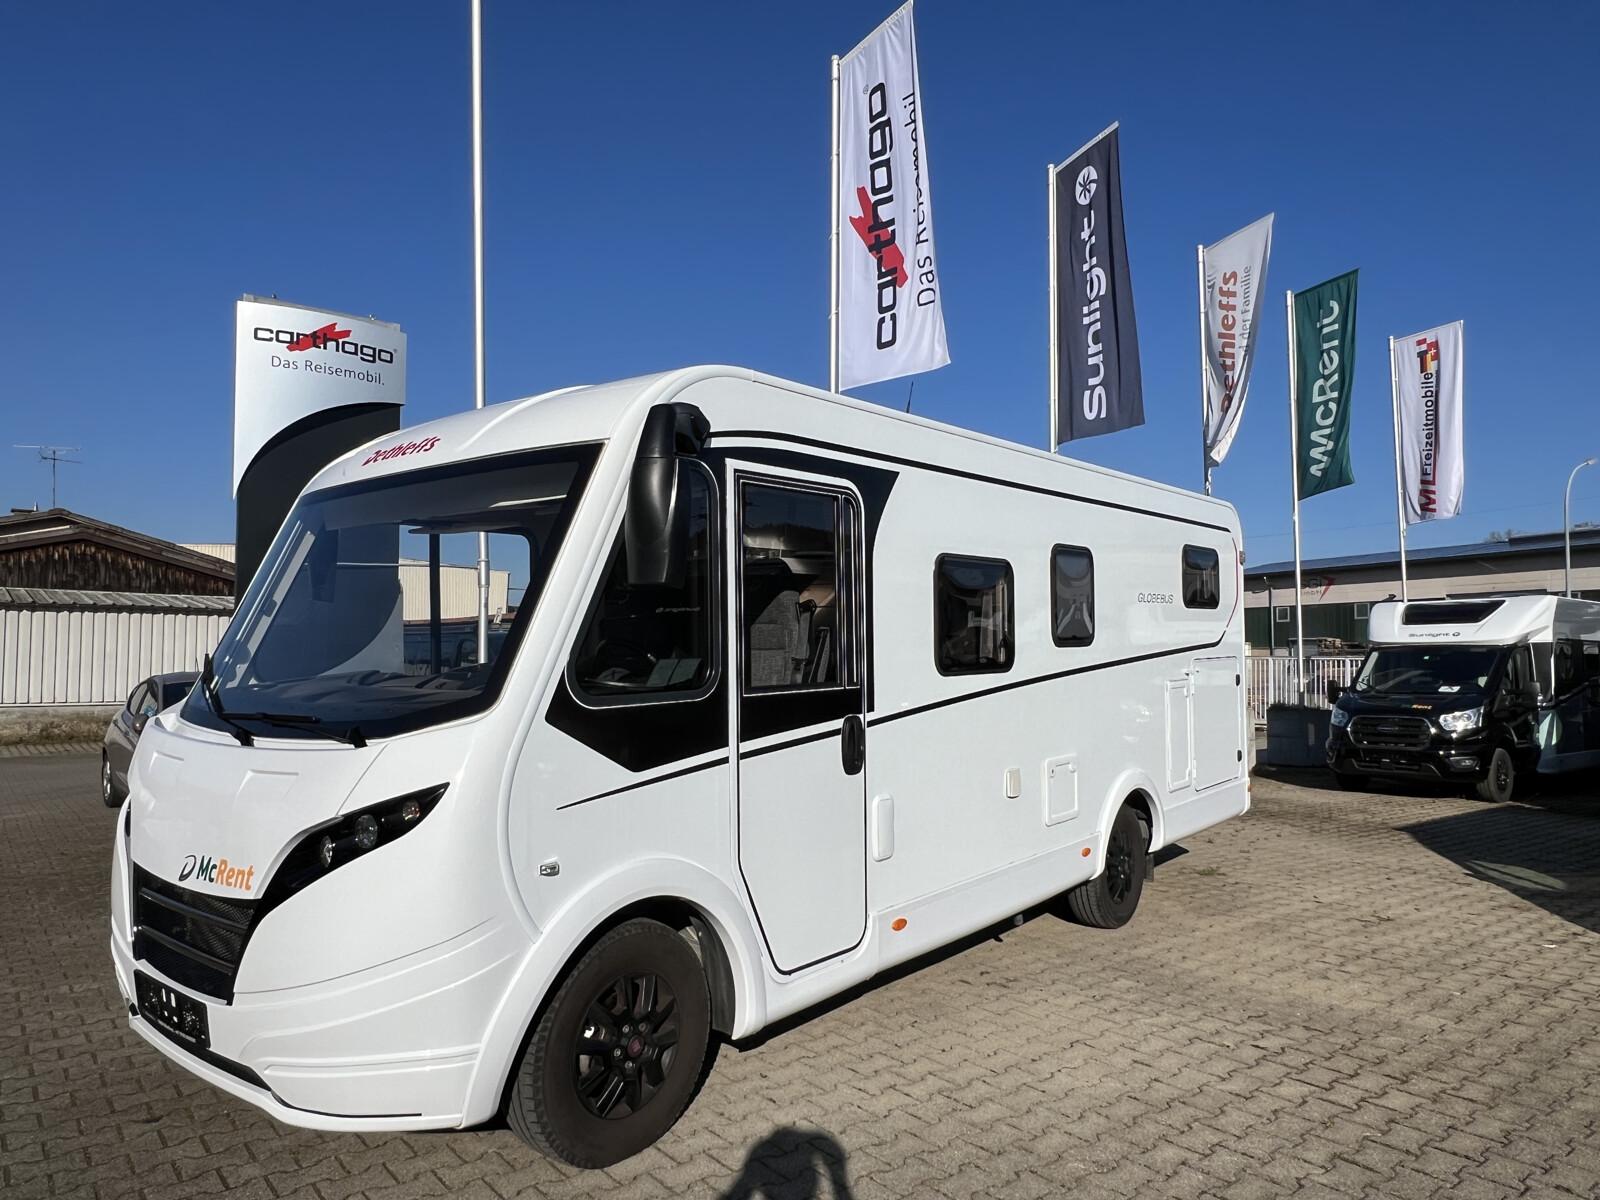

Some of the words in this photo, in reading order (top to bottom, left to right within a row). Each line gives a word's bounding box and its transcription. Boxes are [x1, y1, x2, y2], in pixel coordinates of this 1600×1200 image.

[867, 81, 897, 351] carthago
[916, 254, 936, 308] Das
[1240, 265, 1252, 315] Familie
[1080, 209, 1107, 421] Sunlight
[253, 326, 394, 364] carthago
[270, 355, 299, 370] Das
[304, 359, 386, 386] Reisemobil.
[1421, 371, 1435, 477] Freizeitmobile
[196, 855, 255, 891] McRent
